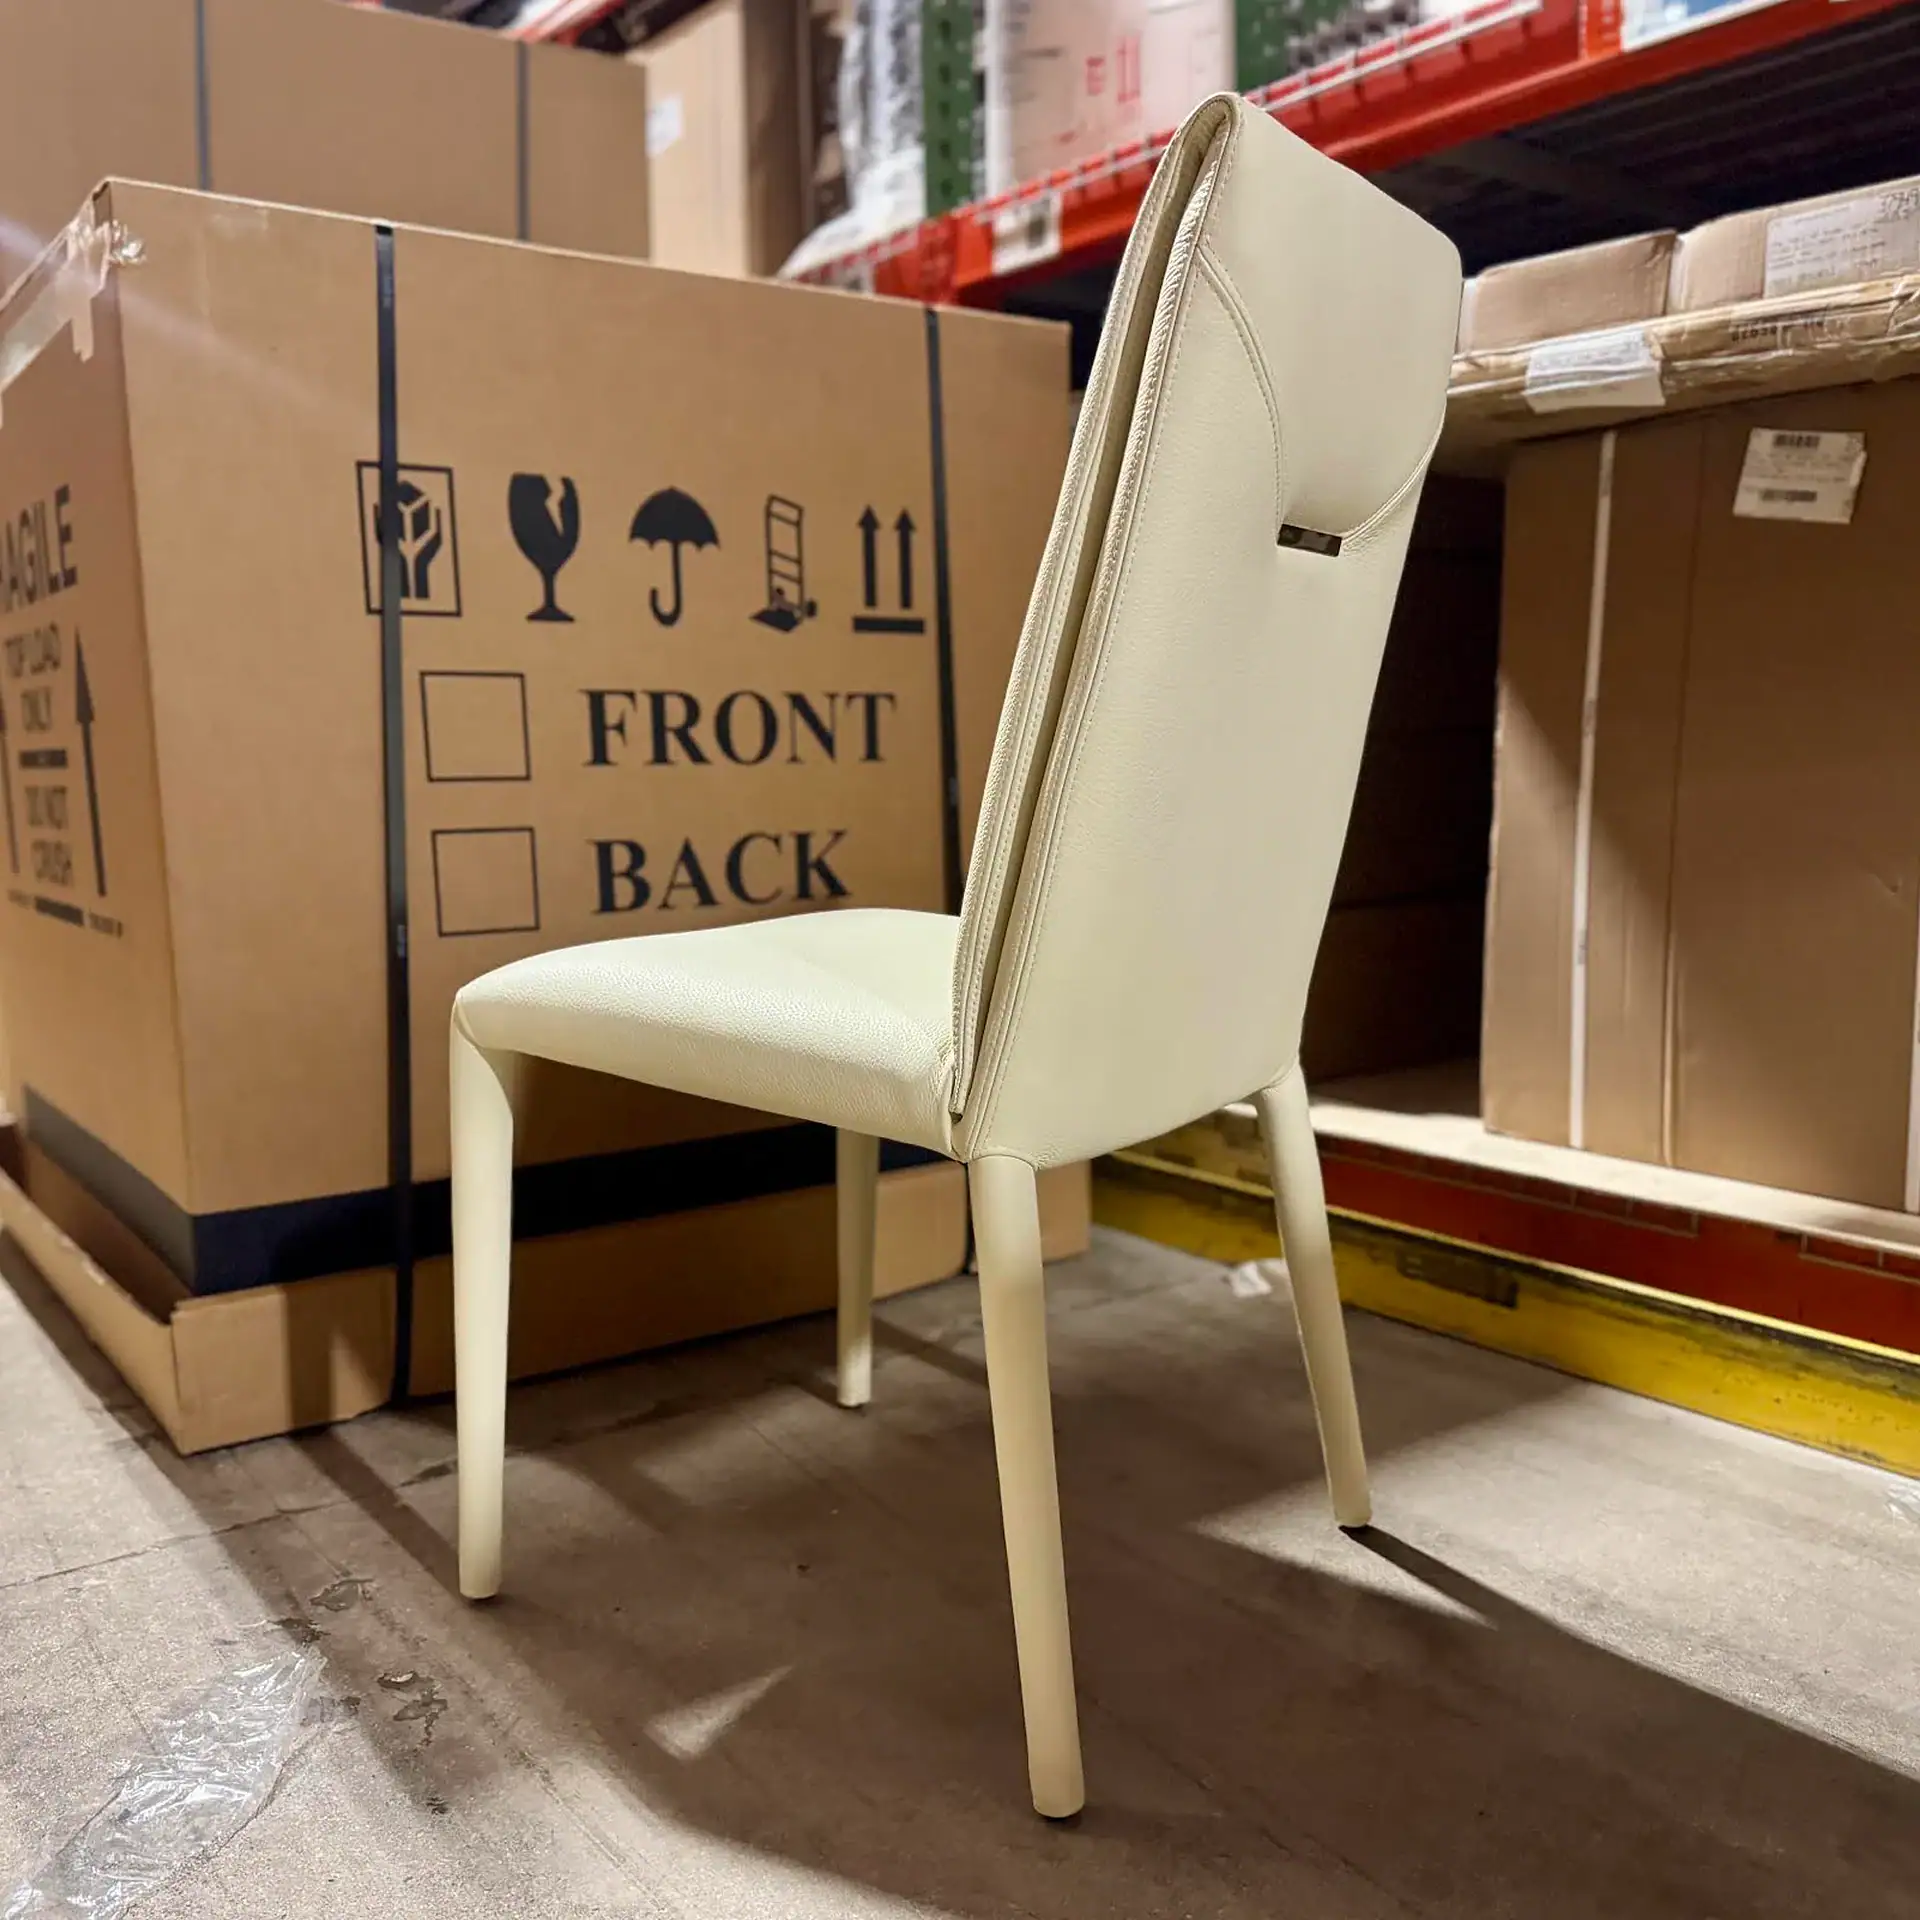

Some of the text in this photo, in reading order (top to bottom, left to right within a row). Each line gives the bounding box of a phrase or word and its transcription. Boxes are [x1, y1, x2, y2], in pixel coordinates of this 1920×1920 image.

[0, 484, 78, 614] AGILE
[579, 688, 898, 767] FRONT
[586, 828, 853, 915] BACK
